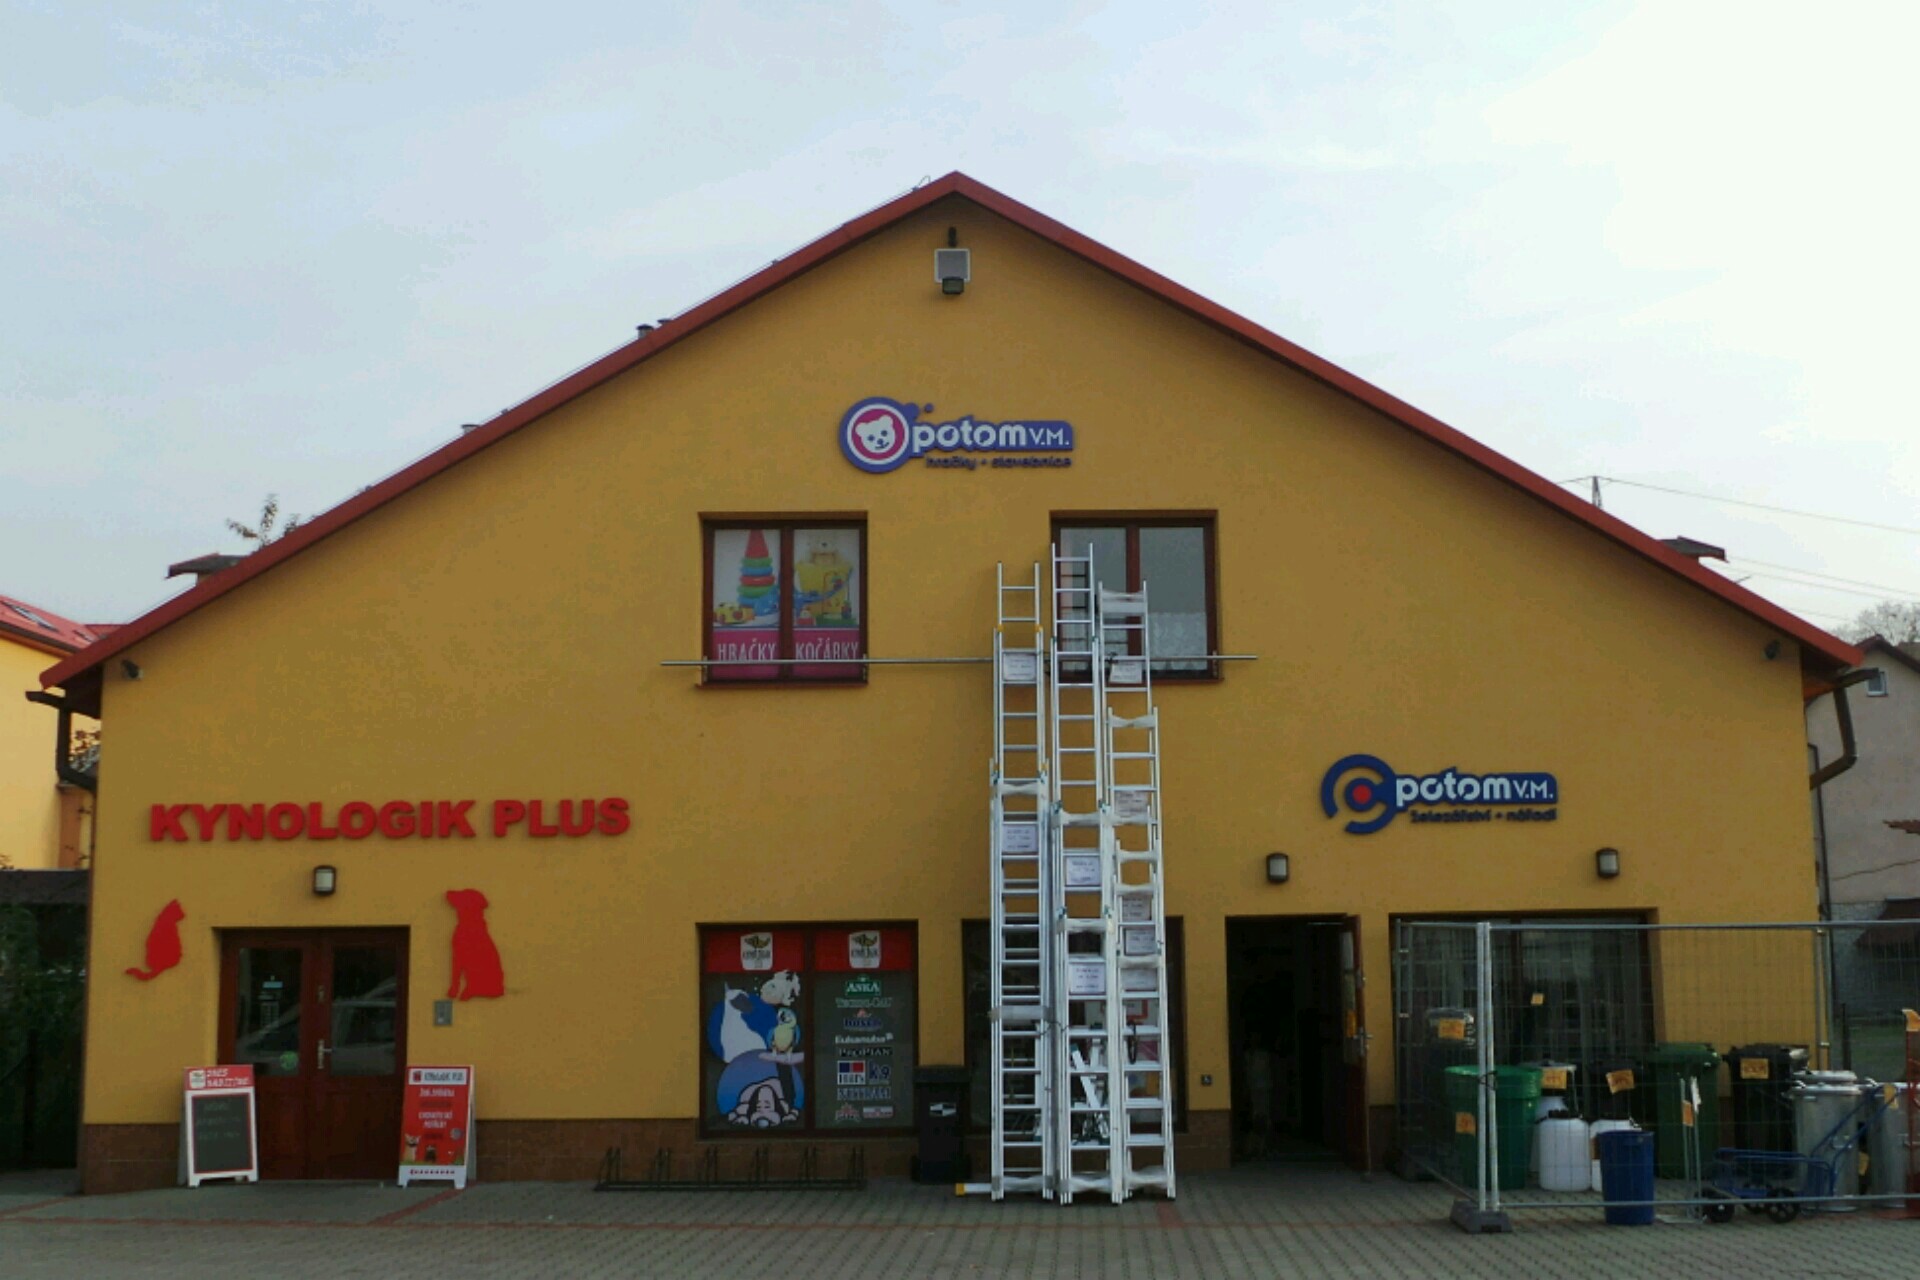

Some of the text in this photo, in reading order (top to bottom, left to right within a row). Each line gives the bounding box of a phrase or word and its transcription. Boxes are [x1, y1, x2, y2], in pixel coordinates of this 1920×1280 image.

[913, 420, 1069, 452] potom V.M.
[717, 638, 777, 661] HRAČKY
[795, 637, 859, 661] KOČÁRKY
[1396, 772, 1554, 806] potom V.M.
[150, 797, 631, 842] KYNOLOGIK PLUS
